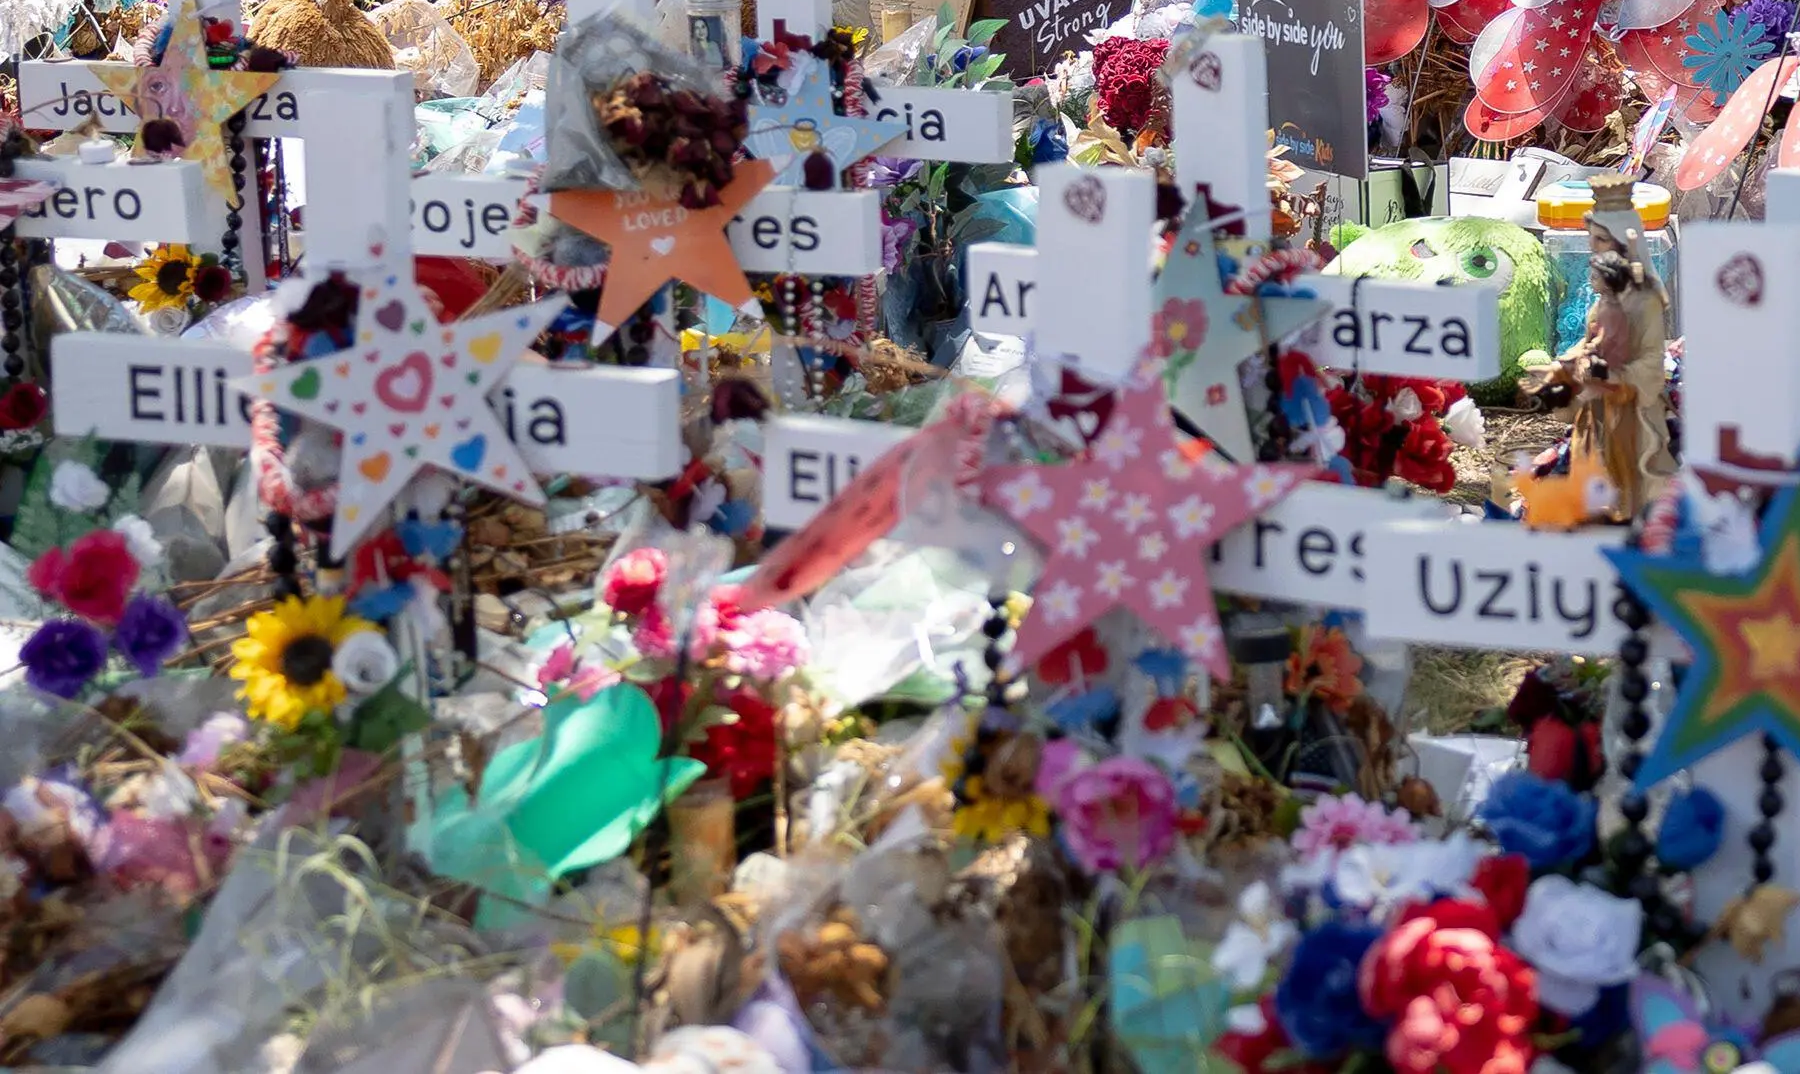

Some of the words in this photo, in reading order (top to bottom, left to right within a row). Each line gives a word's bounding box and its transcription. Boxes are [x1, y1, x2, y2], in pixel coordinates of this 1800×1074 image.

[1036, 1, 1113, 54] Strong
[1241, 6, 1266, 38] side
[1266, 14, 1282, 46] by
[1283, 7, 1308, 45] side
[1310, 20, 1346, 76] you
[621, 205, 689, 232] LOVED
